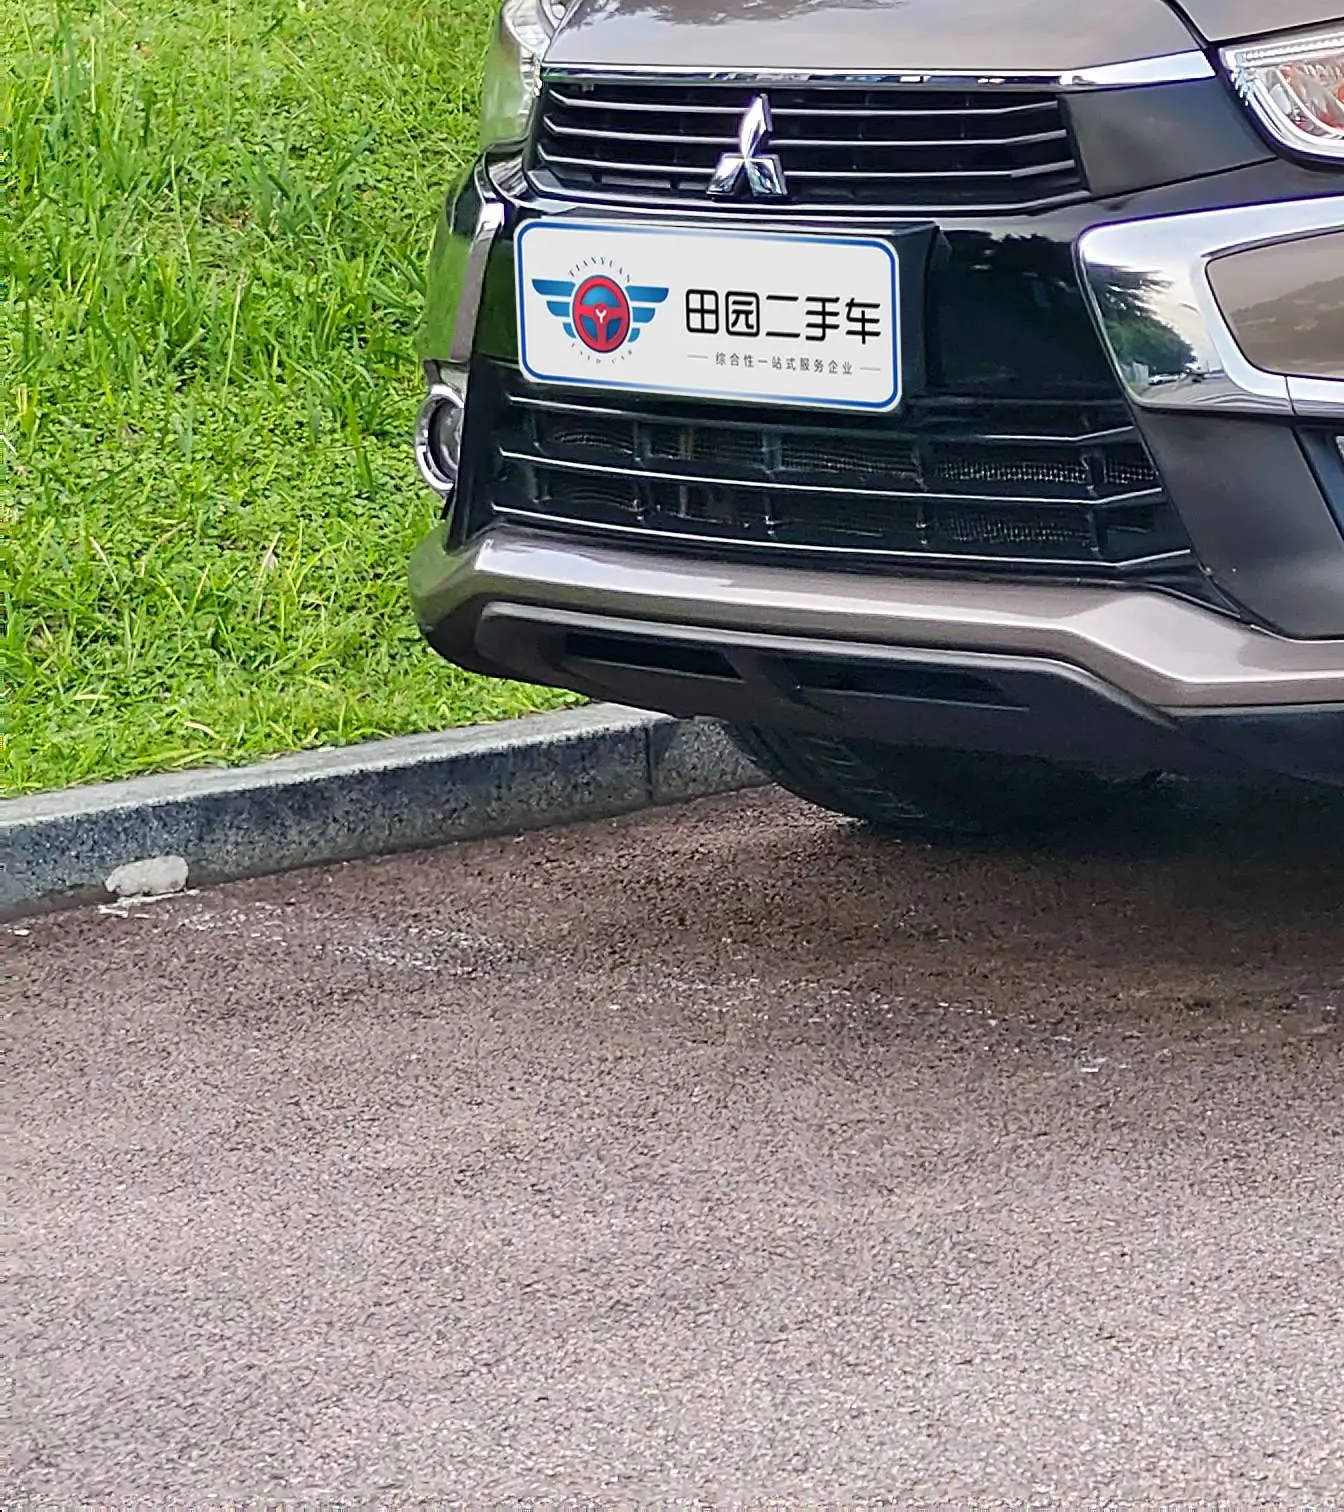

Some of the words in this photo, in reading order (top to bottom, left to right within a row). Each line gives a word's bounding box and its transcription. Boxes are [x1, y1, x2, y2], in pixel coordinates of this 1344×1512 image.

[686, 289, 881, 345] 田园二手车
[715, 351, 853, 376] 综合性一站式服务企业
